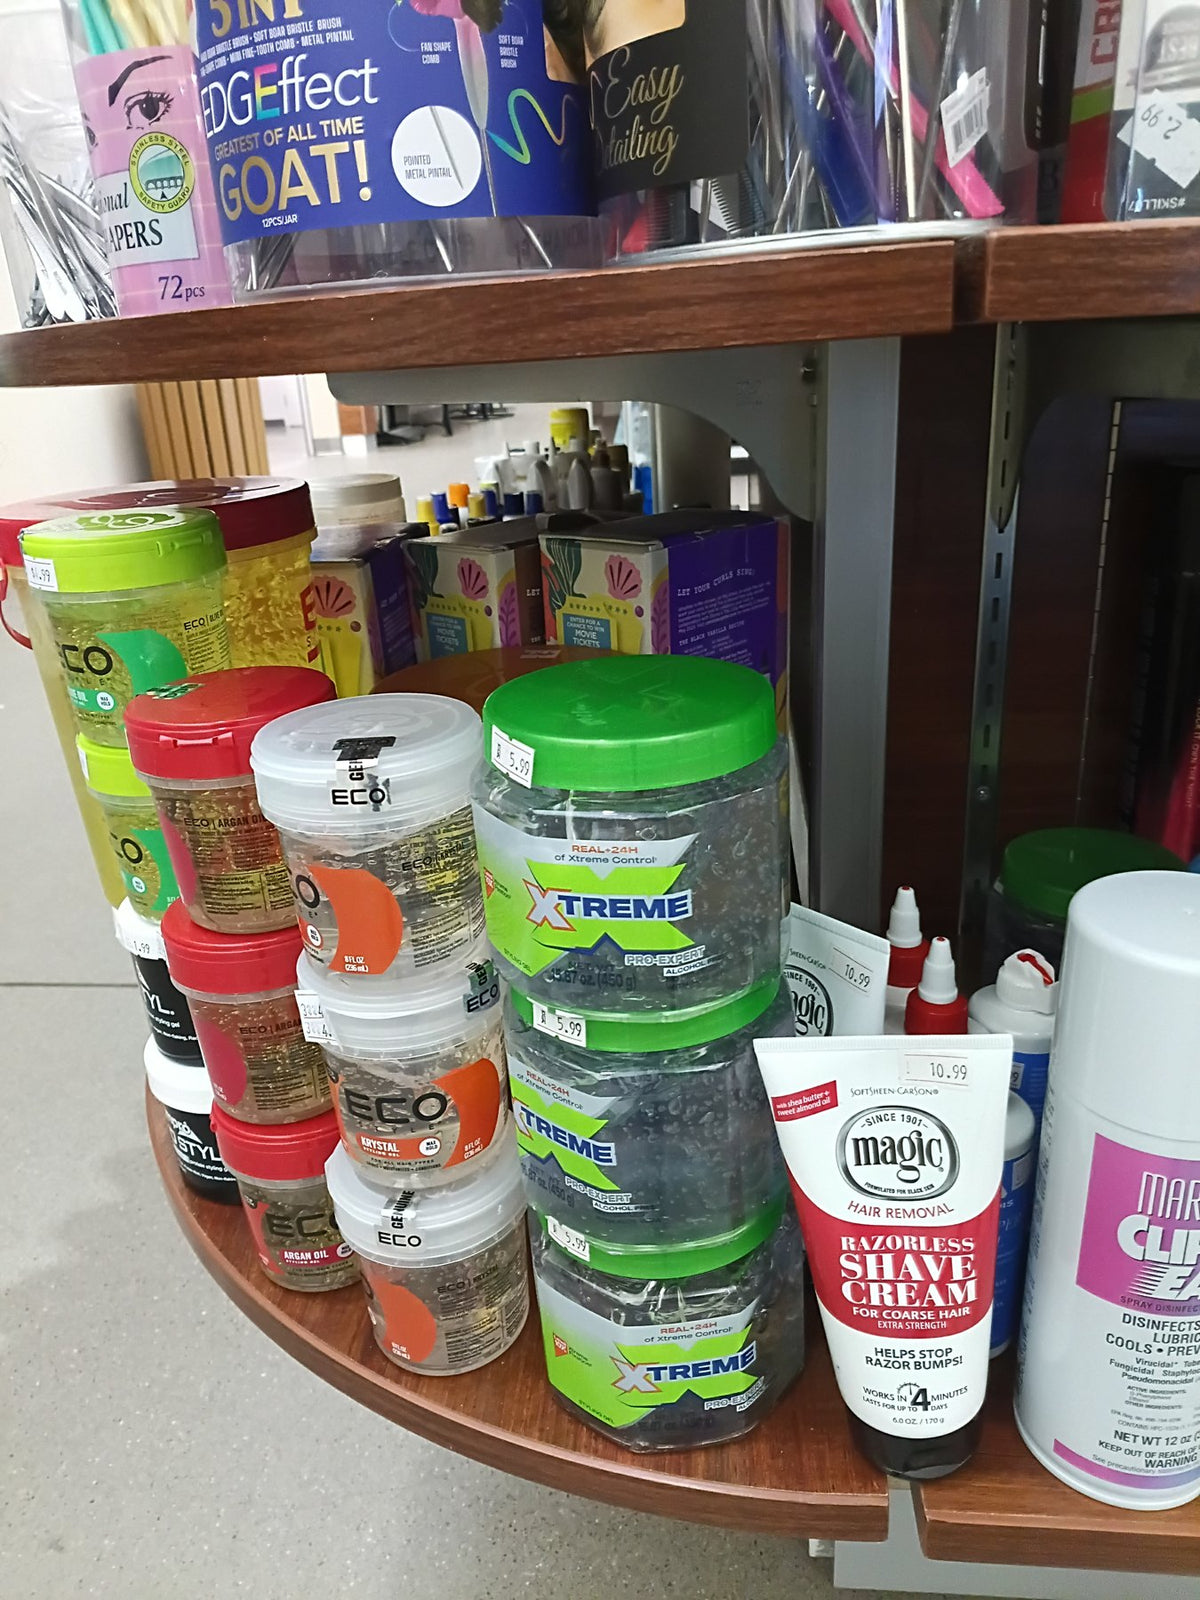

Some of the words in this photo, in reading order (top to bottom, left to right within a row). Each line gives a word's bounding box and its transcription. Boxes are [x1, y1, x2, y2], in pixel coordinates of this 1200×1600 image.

[253, 29, 268, 43] SOFT
[269, 25, 286, 40] BOAR
[287, 21, 313, 36] BRISTLE
[317, 17, 342, 31] BRUSH
[276, 38, 295, 52] COMB
[301, 33, 324, 47] METAL
[326, 30, 354, 43] PINTAIL
[420, 42, 433, 52] FAN
[433, 41, 452, 52] SHAPE
[422, 54, 440, 64] COMB
[604, 45, 684, 125] Easy
[1141, 103, 1183, 141] 2.99
[214, 133, 259, 161] GREATEST
[263, 128, 283, 147] OF
[287, 123, 317, 143] ALL
[319, 116, 364, 137] TIME
[602, 114, 679, 176] tailing
[131, 135, 165, 166] STAINLESS
[168, 139, 190, 166] STEEL
[403, 154, 431, 166] POINTED
[219, 139, 372, 221] GOAT!
[405, 168, 427, 180] METAL
[427, 167, 452, 179] PINTAIL
[139, 191, 165, 211] SAFETY
[168, 186, 190, 210] GUARD
[262, 214, 298, 228] 12PCS/JAR
[158, 275, 183, 300] 72
[185, 286, 205, 302] pcs
[183, 617, 206, 631] ECO
[573, 637, 601, 648] TICKETS
[575, 630, 597, 639] MOVIE
[510, 752, 530, 776] 5.99
[332, 788, 386, 806] ECO
[218, 815, 249, 828] ARGAN
[402, 856, 432, 871] ECO
[554, 853, 565, 862] of
[568, 854, 609, 864] Xtreme
[612, 855, 657, 864] Control
[523, 879, 692, 931] XTREME
[625, 946, 706, 966] PRO-EXPERT
[665, 960, 706, 975] ALCOHOL
[845, 964, 871, 987] 10.99
[466, 984, 499, 1013] ECO
[240, 1026, 268, 1035] ECO
[274, 1019, 302, 1032] ARGA
[558, 1017, 582, 1037] 5.99
[929, 1062, 968, 1080] 10.99
[525, 1076, 551, 1095] Xtreme
[344, 1088, 448, 1124] ECO
[777, 1108, 796, 1117] sweet
[796, 1100, 822, 1113] almond
[822, 1097, 831, 1106] oil
[787, 1099, 803, 1107] shea
[360, 1135, 400, 1153] KRYSTAL
[851, 1129, 944, 1185] magic
[565, 1176, 632, 1203] PRO-EXPERT
[864, 1182, 895, 1194] FORMULATED
[907, 1186, 922, 1194] BLACK
[923, 1184, 935, 1192] SKIN
[391, 1190, 415, 1229] GENUINE
[594, 1202, 633, 1212] ALCOHOL
[848, 1200, 880, 1218] HAIR
[886, 1202, 954, 1219] REMOVAL
[378, 1231, 422, 1248] ECO
[566, 1232, 587, 1251] 5.99
[841, 1235, 974, 1253] RAZORLESS
[284, 1251, 311, 1260] ARGAN
[314, 1250, 329, 1259] OIL
[839, 1254, 975, 1282] SHAVE
[436, 1282, 465, 1294] ECO
[841, 1279, 978, 1307] CREAM
[1120, 1295, 1153, 1310] SPRAY
[853, 1306, 880, 1318] FOR
[882, 1309, 935, 1320] COARSE
[938, 1306, 971, 1318] HAIR
[877, 1321, 903, 1330] EXTRA
[905, 1321, 947, 1330] STRENGTH
[1122, 1313, 1200, 1332] DISINFECTS
[644, 1335, 654, 1344] of
[656, 1332, 694, 1343] Xtreme
[695, 1326, 733, 1339] Control
[1106, 1333, 1153, 1355] COOLS
[874, 1347, 915, 1359] HELPS
[919, 1347, 953, 1359] STOP
[609, 1341, 757, 1394] XTREME
[865, 1356, 911, 1370] RAZOR
[914, 1356, 963, 1370] BUMPS!
[1110, 1359, 1154, 1375] Fungicidal
[862, 1385, 895, 1401] WORKS
[910, 1387, 931, 1412] 4
[931, 1385, 968, 1402] MINUTES
[862, 1396, 881, 1408] LASTS
[882, 1402, 896, 1411] FOR
[931, 1403, 948, 1412] DAYS
[892, 1417, 904, 1425] 6.0
[925, 1417, 939, 1425] 170
[1114, 1430, 1139, 1443] NET
[1142, 1436, 1161, 1446] WT
[1165, 1437, 1178, 1446] 12
[1181, 1435, 1192, 1444] oz
[1099, 1440, 1121, 1453] KEEP
[1124, 1448, 1143, 1457] OUT
[1158, 1449, 1186, 1459] REACH
[1188, 1446, 1197, 1454] OF
[1093, 1454, 1106, 1464] See
[1107, 1459, 1160, 1475] precautionary
[1145, 1452, 1198, 1468] WARNING
